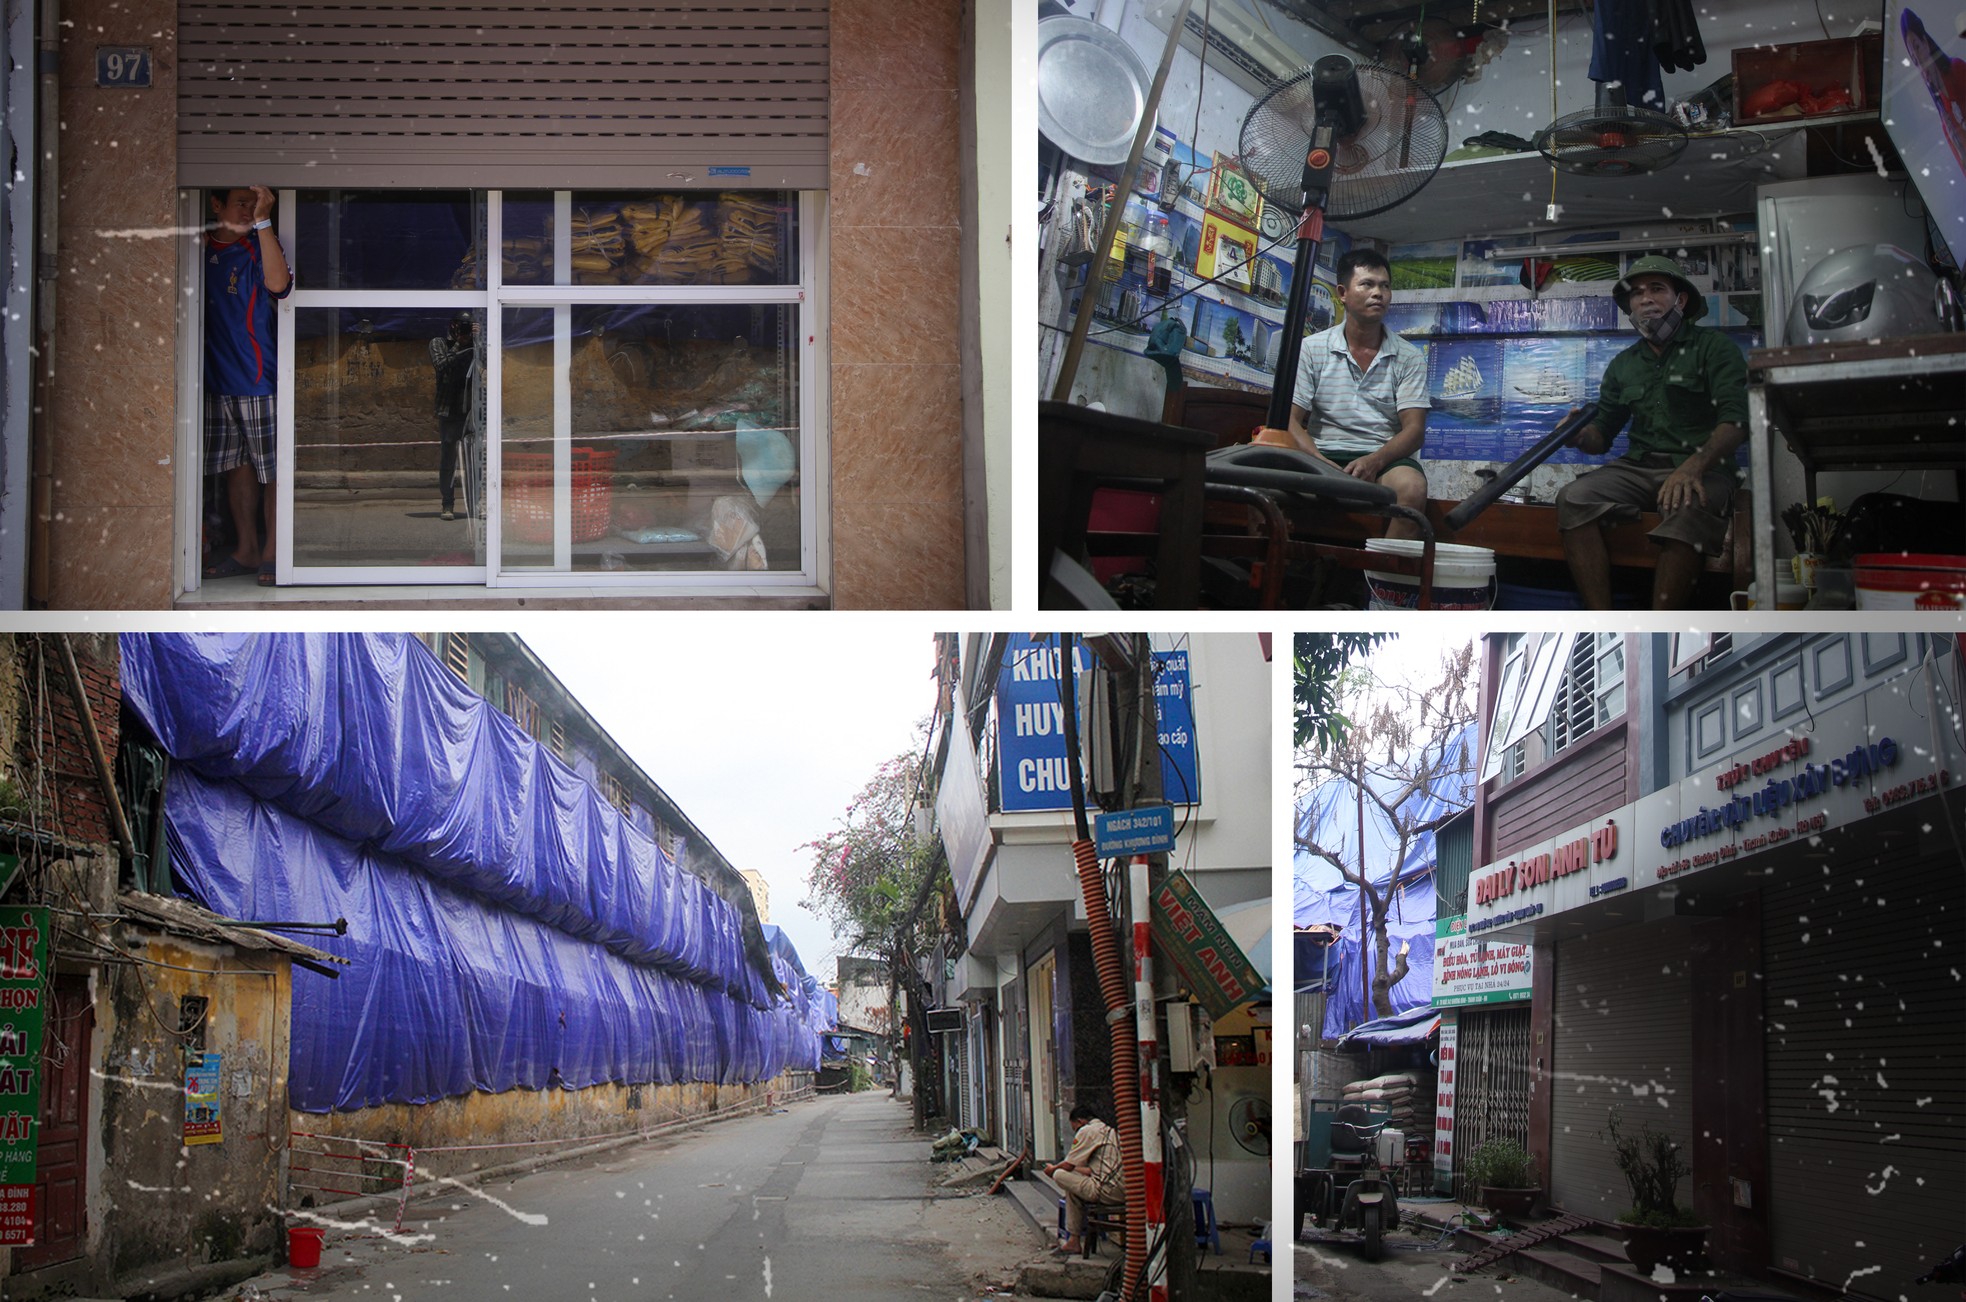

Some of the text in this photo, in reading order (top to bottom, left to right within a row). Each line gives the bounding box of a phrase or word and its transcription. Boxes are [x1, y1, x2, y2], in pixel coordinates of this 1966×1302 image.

[107, 53, 141, 81] 97
[1158, 732, 1170, 746] ao
[1550, 837, 1589, 880] ANH
[1157, 886, 1204, 944] VIỆT
[1195, 945, 1246, 1003] ANH
[1214, 934, 1244, 971] NON
